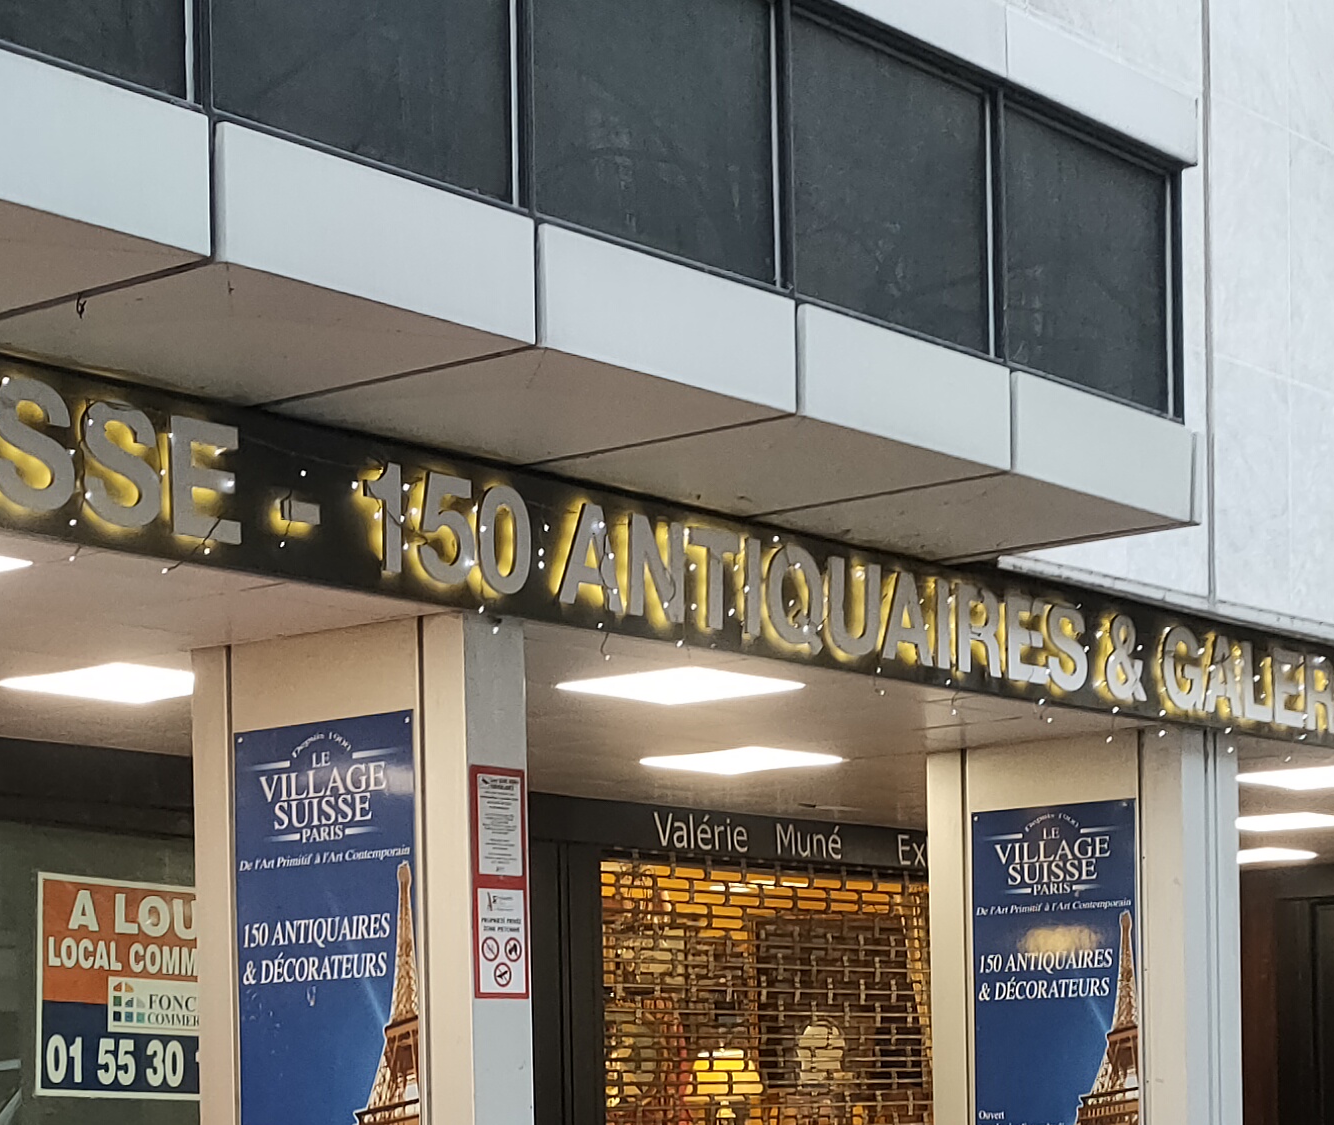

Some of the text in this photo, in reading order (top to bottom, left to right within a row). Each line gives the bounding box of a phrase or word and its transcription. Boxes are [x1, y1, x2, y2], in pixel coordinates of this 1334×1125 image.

[364, 461, 533, 596] 150
[559, 502, 1089, 693] ANTIQUAIRES
[1105, 614, 1148, 702] &
[312, 751, 331, 768] LE
[259, 761, 387, 802] VILLAGE
[273, 793, 373, 830] SUISSE
[301, 825, 344, 843] PARIS
[653, 811, 931, 868] Valérie Muné Ex
[1043, 827, 1060, 840] LE
[239, 844, 411, 872] De l'Art Primitif à l'Art Contemporain
[994, 835, 1111, 865] VILLAGE
[1008, 858, 1098, 886] SUISSE
[1033, 882, 1071, 896] PARIS
[68, 889, 197, 940] A LOU
[976, 906, 989, 916] De
[1010, 902, 1042, 914] Primitif
[1072, 897, 1132, 911] Contemporain
[243, 912, 391, 949] 150 ANTIQUAIRES
[48, 936, 122, 971] LOCAL
[979, 949, 1113, 974] 150 ANTIQUAIRES
[242, 951, 388, 986] & DÉCORATEURS
[978, 976, 1110, 1001] & DÉCORATEURS
[46, 1034, 185, 1088] 01 55 30
[979, 1110, 1005, 1120] Ouvert
